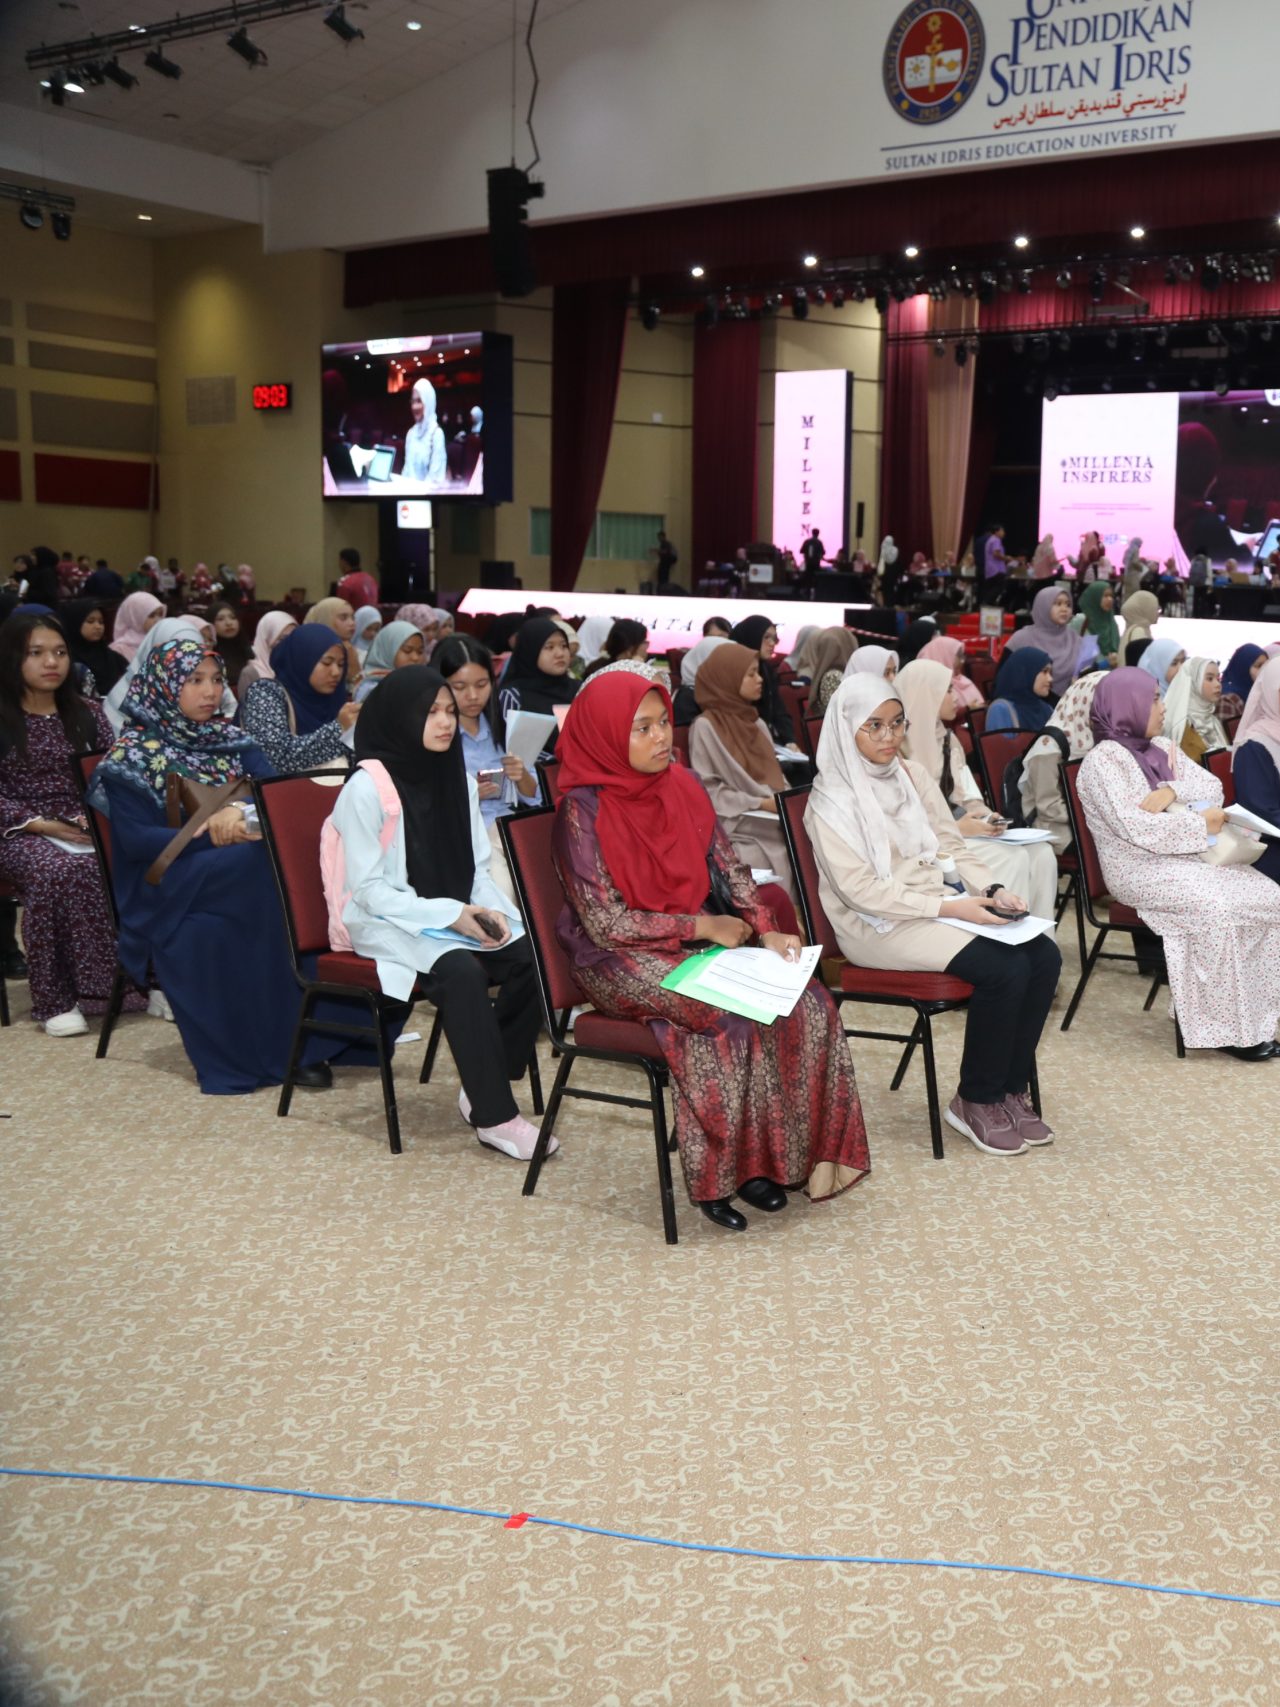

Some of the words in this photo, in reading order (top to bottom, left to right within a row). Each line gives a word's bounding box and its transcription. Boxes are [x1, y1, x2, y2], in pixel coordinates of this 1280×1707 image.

[1010, 0, 1193, 66] PENDIDIKAN
[987, 53, 1101, 107] SULTAN
[1109, 42, 1192, 92] IDRIS
[885, 152, 937, 170] SULTAN
[941, 147, 981, 164] IDRIS
[986, 136, 1075, 159] EDUCATION
[1080, 124, 1177, 148] UNIVERSITY
[801, 415, 814, 537] MILLEN
[1063, 471, 1152, 483] INSPIRERS
